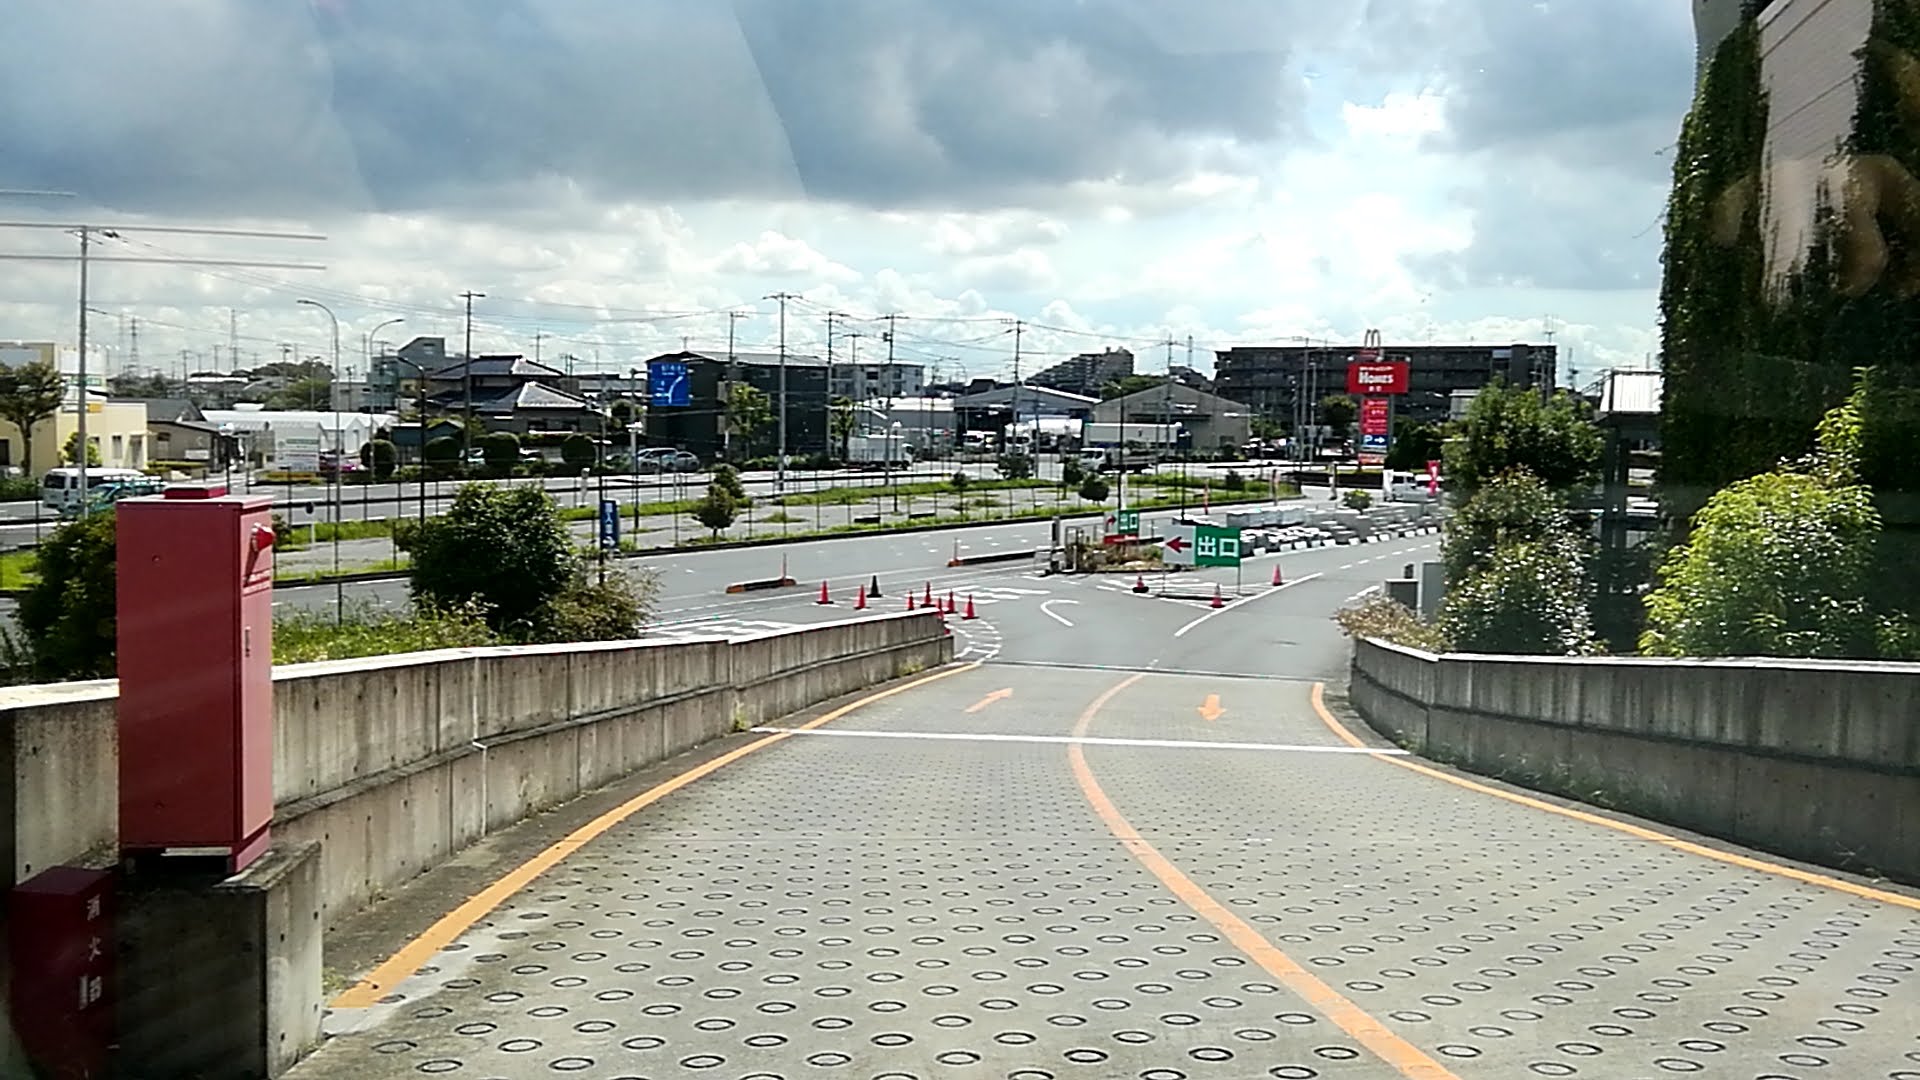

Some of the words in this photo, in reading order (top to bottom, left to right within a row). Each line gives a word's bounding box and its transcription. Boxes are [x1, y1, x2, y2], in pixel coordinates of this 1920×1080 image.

[1364, 434, 1374, 446] P
[1119, 512, 1139, 531] 出口
[1197, 535, 1240, 558] 出口
